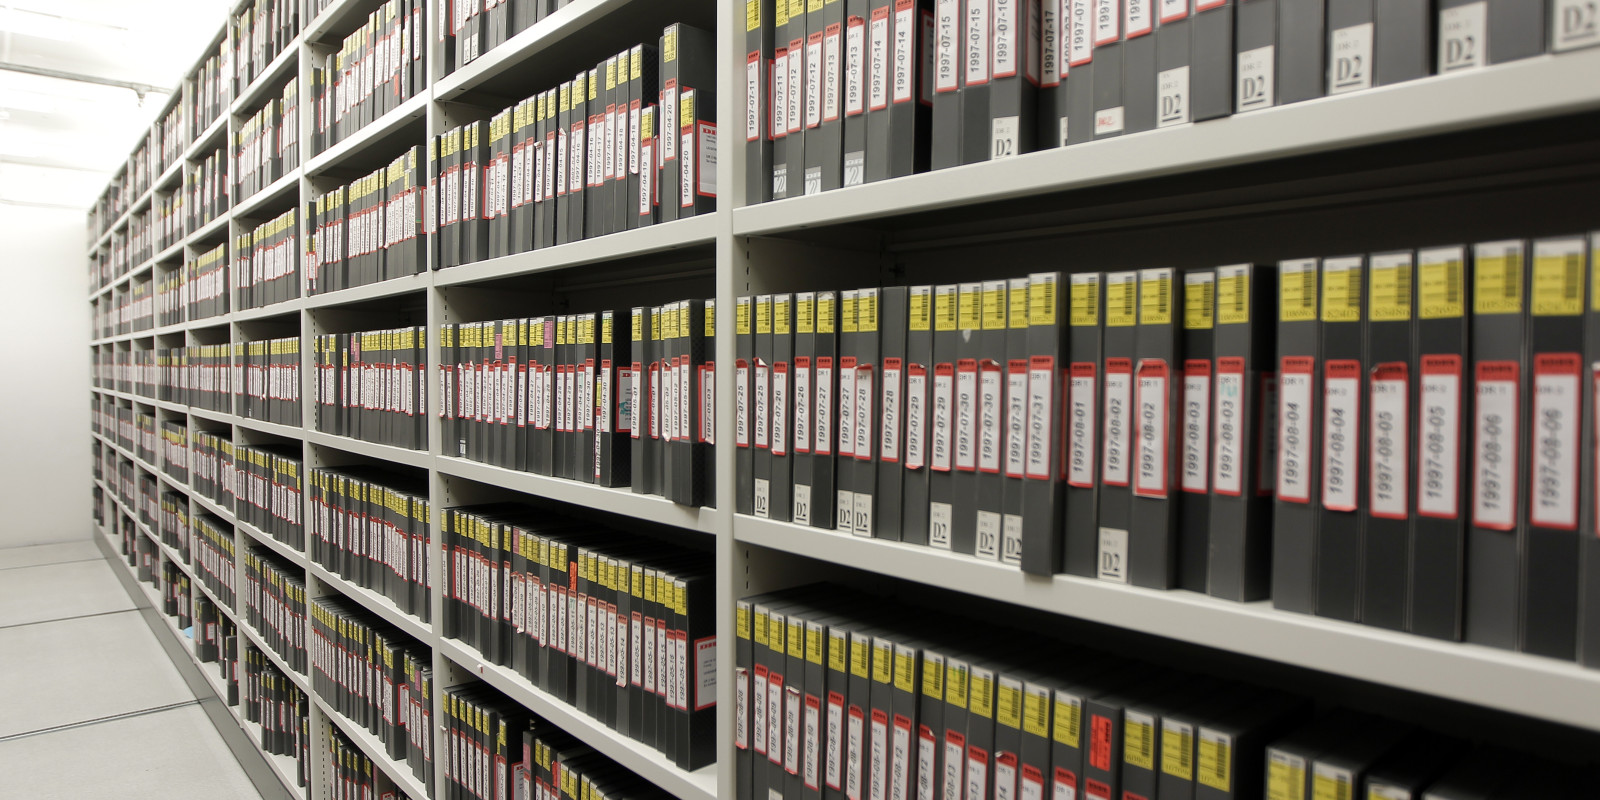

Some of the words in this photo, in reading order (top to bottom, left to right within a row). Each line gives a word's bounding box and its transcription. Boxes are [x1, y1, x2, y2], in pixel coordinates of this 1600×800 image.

[940, 15, 950, 78] 1997-07-15
[971, 8, 980, 72] 1997-07-15
[1045, 10, 1054, 74] 1997-07-17
[1563, 3, 1598, 34] D2
[1336, 55, 1363, 82] D2
[1445, 36, 1476, 65] D2
[1162, 93, 1181, 116] D2
[1241, 75, 1265, 100] D2
[995, 138, 1012, 157] D2
[858, 389, 866, 448] 1997-07-28
[884, 390, 894, 450] 1997-07-28
[910, 396, 919, 457] 1997-07-29
[936, 397, 946, 459] 1997-07-29
[960, 393, 970, 456] 1997-07-30
[983, 393, 993, 459] 1997-07-30
[1010, 397, 1021, 464] 1997-07-31
[1032, 394, 1043, 465] 1997-07-31
[1073, 402, 1086, 472] 1997-08-01
[1109, 398, 1122, 471] 1997-08-02
[1142, 402, 1155, 478] 1997-08-02
[1187, 401, 1200, 478] 1997-08-03
[1221, 401, 1234, 479] 1997-08-03
[1285, 402, 1300, 486] 1997-08-04
[1329, 408, 1346, 494] 1997-08-04
[1377, 411, 1393, 500] 1997-08-05
[1427, 405, 1446, 498] 1997-08-05
[1482, 414, 1502, 509] 1997-08-06
[1541, 408, 1562, 508] 1997-08-06
[757, 495, 766, 510] D2
[796, 503, 807, 517] D2
[840, 509, 850, 524] D2
[856, 513, 868, 527] D2
[933, 522, 947, 539] D2
[979, 532, 995, 550] D2
[1006, 536, 1021, 555] D2
[1102, 552, 1121, 572] D2
